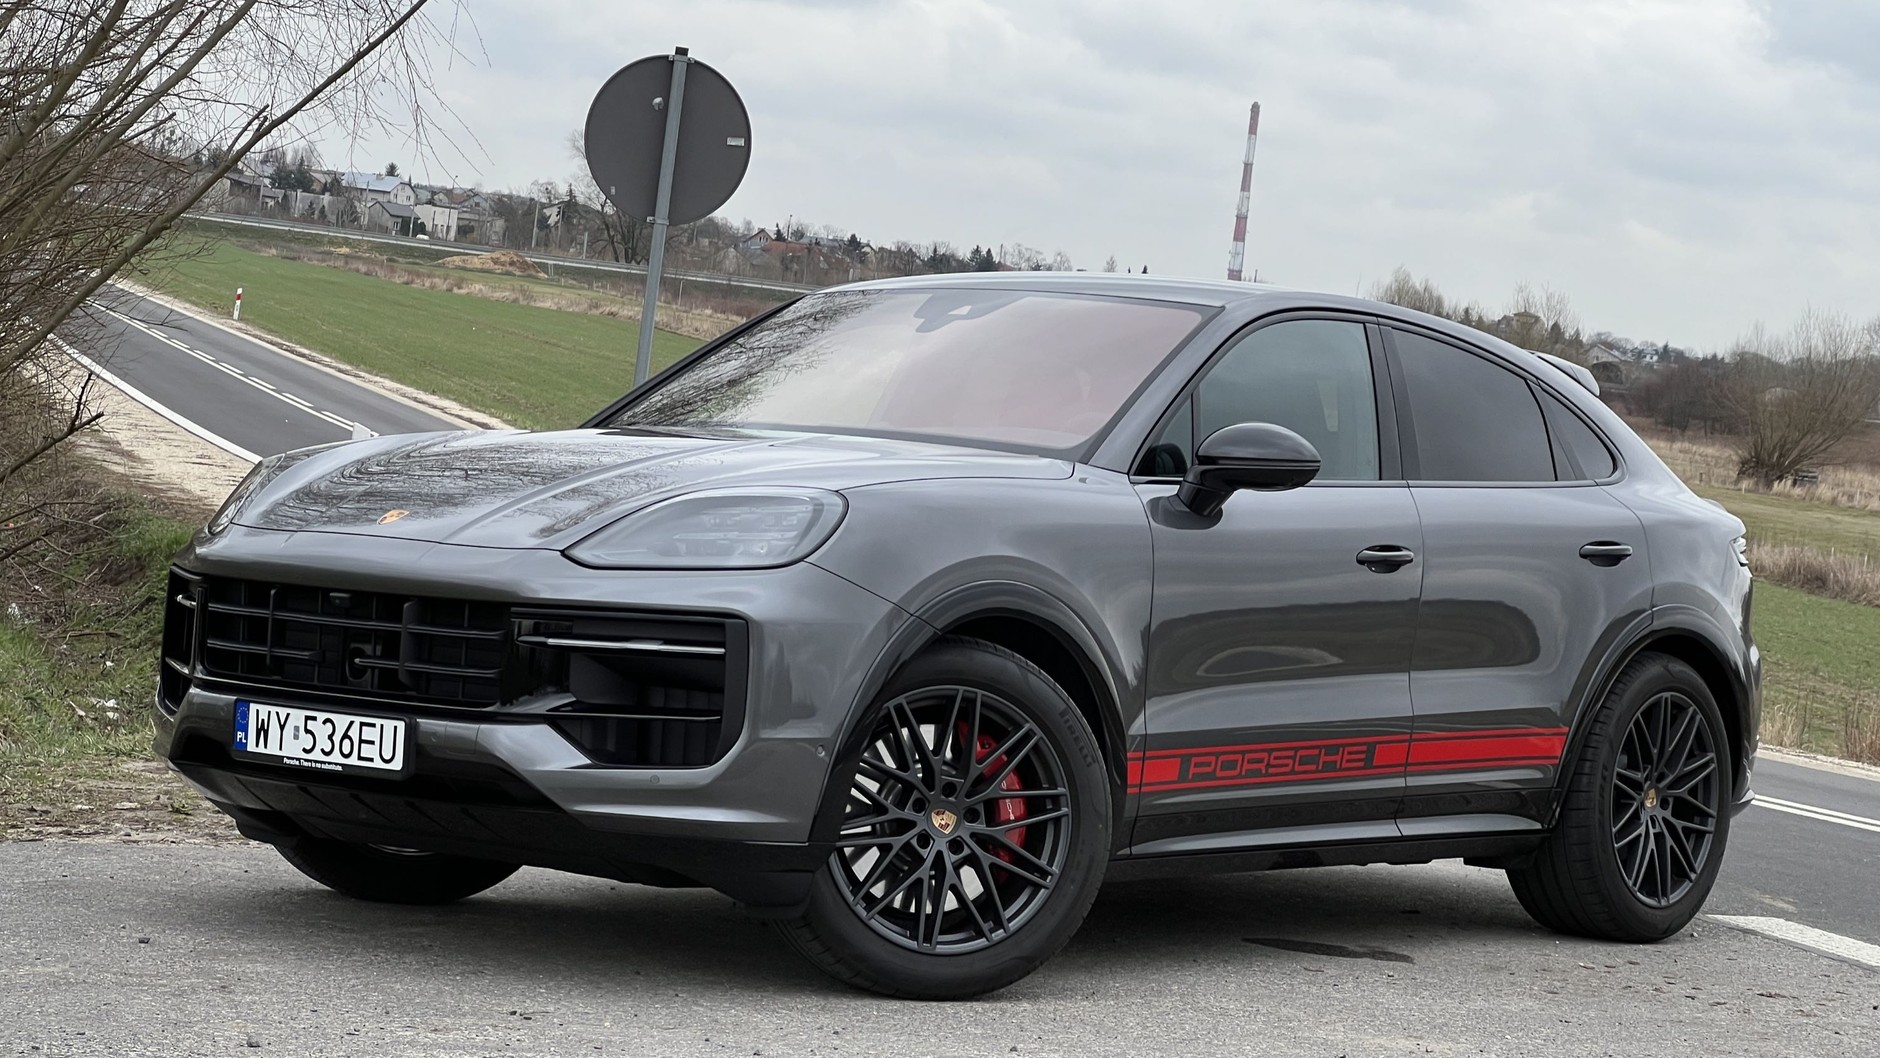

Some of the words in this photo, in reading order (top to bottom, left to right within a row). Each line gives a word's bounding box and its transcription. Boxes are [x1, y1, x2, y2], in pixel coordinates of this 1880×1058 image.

[237, 731, 246, 743] PL
[255, 709, 291, 751] WY
[302, 715, 397, 764] 536EU
[1058, 708, 1096, 768] PIRELLI
[1189, 746, 1367, 779] PORSCHE
